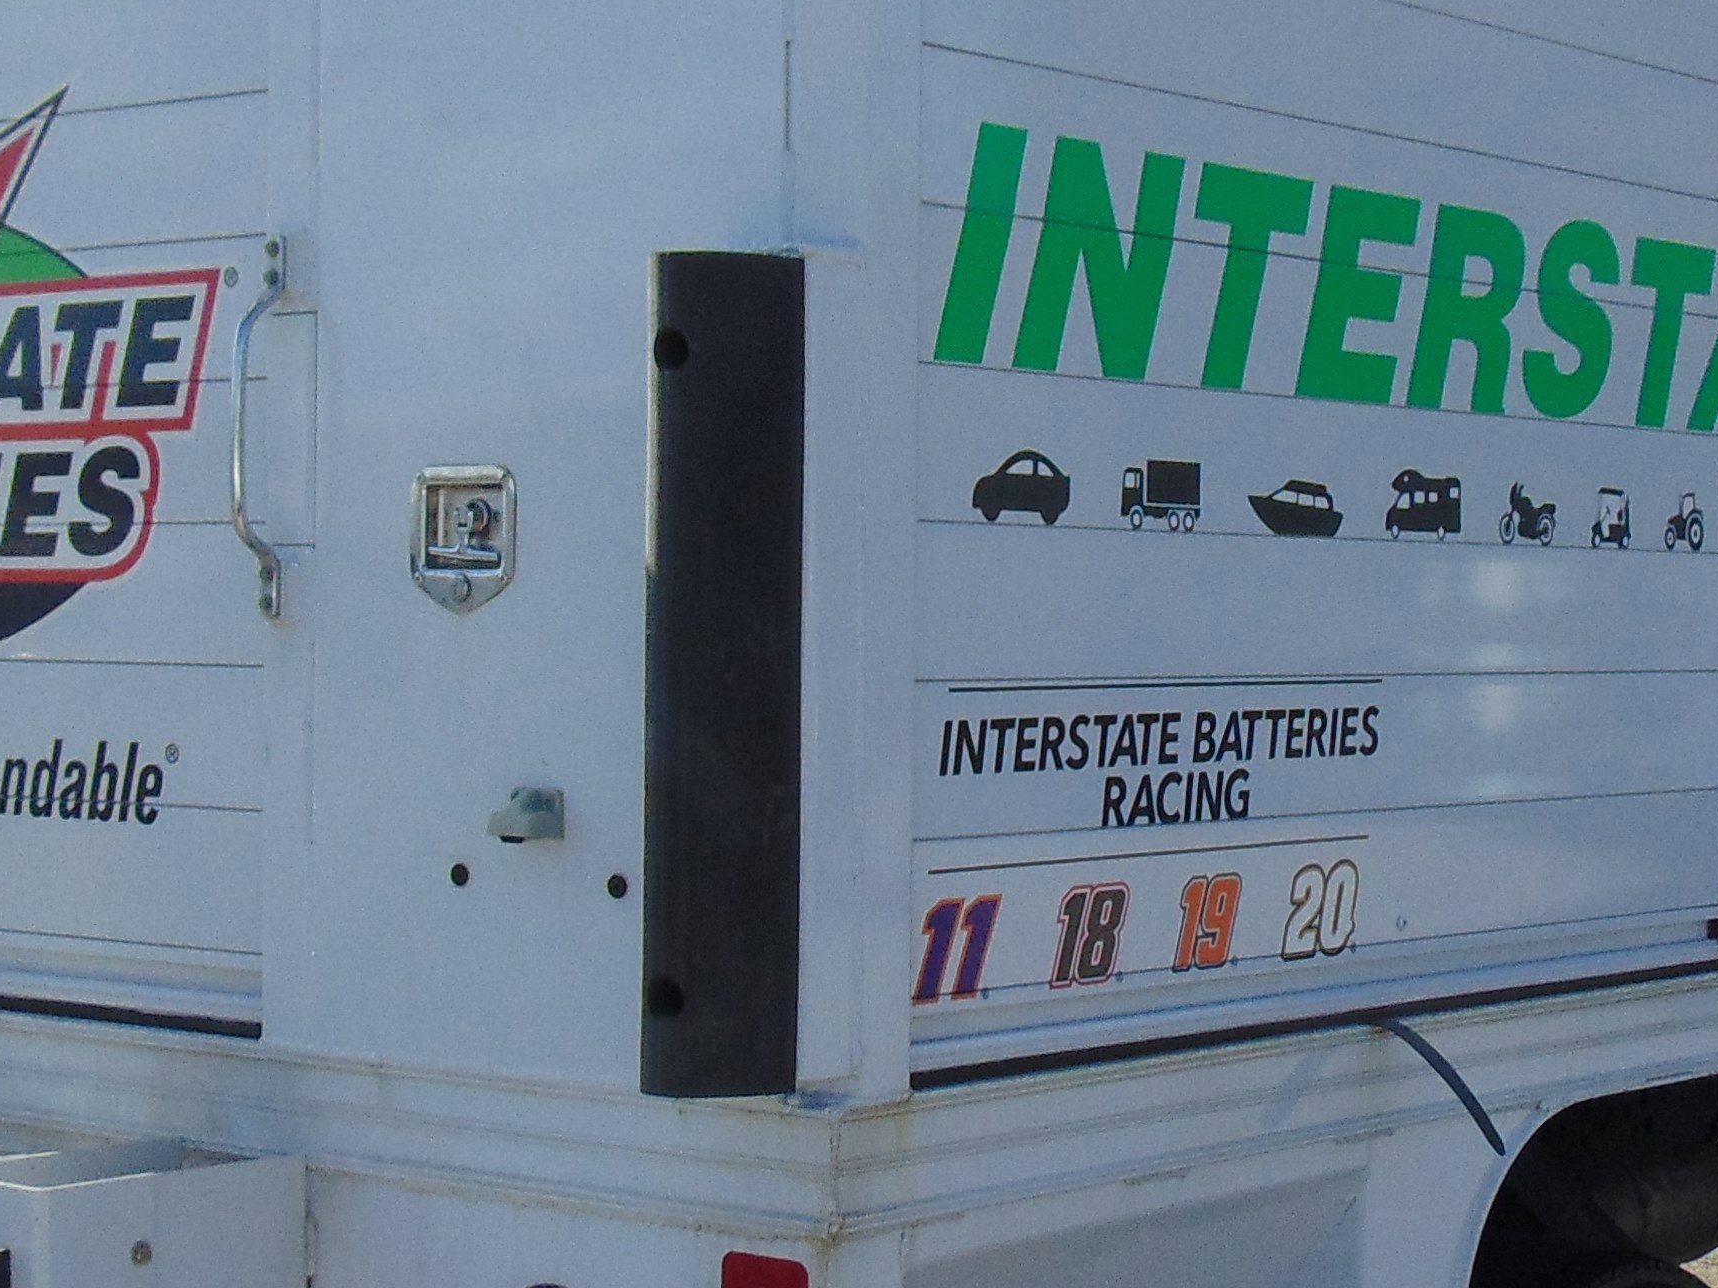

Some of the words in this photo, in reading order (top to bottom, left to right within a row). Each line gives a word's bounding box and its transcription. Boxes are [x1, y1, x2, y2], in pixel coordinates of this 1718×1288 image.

[938, 712, 1182, 777] INTERSTATE
[1192, 706, 1380, 764] BATTERIES
[1101, 768, 1251, 827] RACING
[911, 894, 1003, 1006] 11
[1049, 880, 1131, 990] 18
[1173, 873, 1242, 973] 19
[1281, 858, 1360, 961] 20
